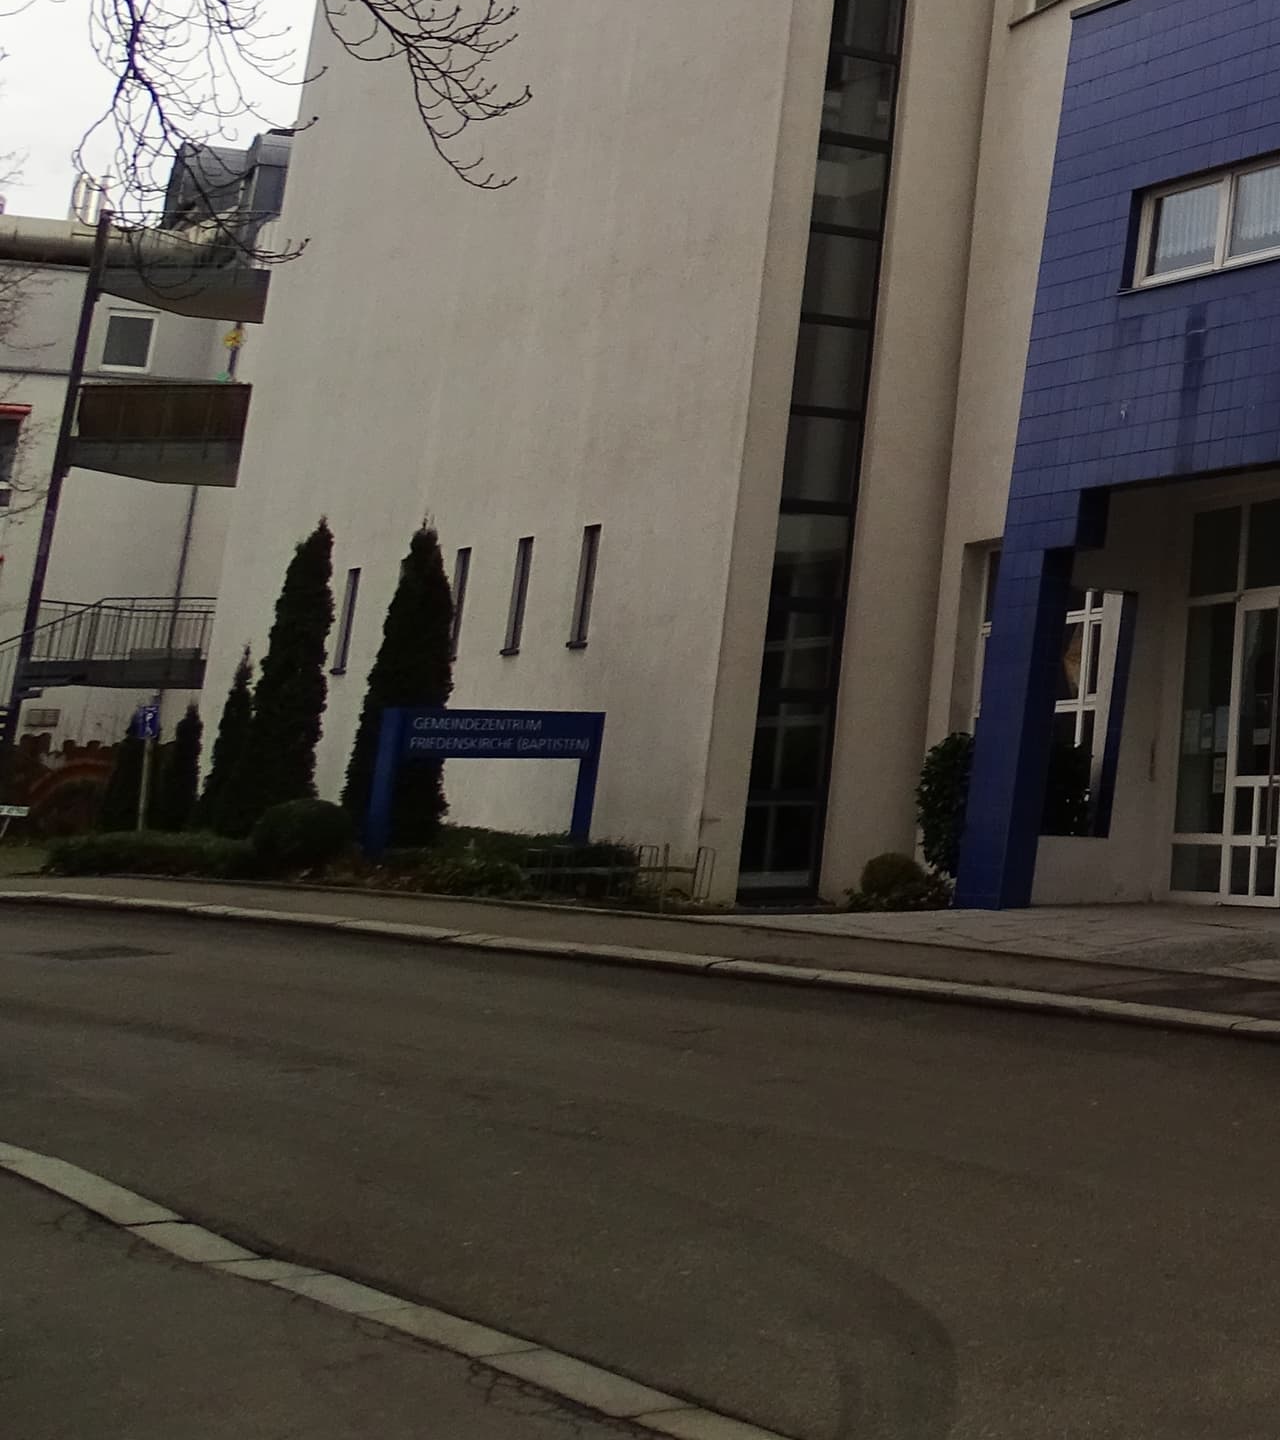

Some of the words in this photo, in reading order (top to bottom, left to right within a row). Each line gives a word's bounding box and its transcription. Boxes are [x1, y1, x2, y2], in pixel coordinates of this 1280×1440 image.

[413, 717, 543, 731] GEMEINDEZENTRUM
[409, 737, 514, 750] FRIEDENSKIRCHE
[517, 738, 590, 752] (BAPTISTEN)
